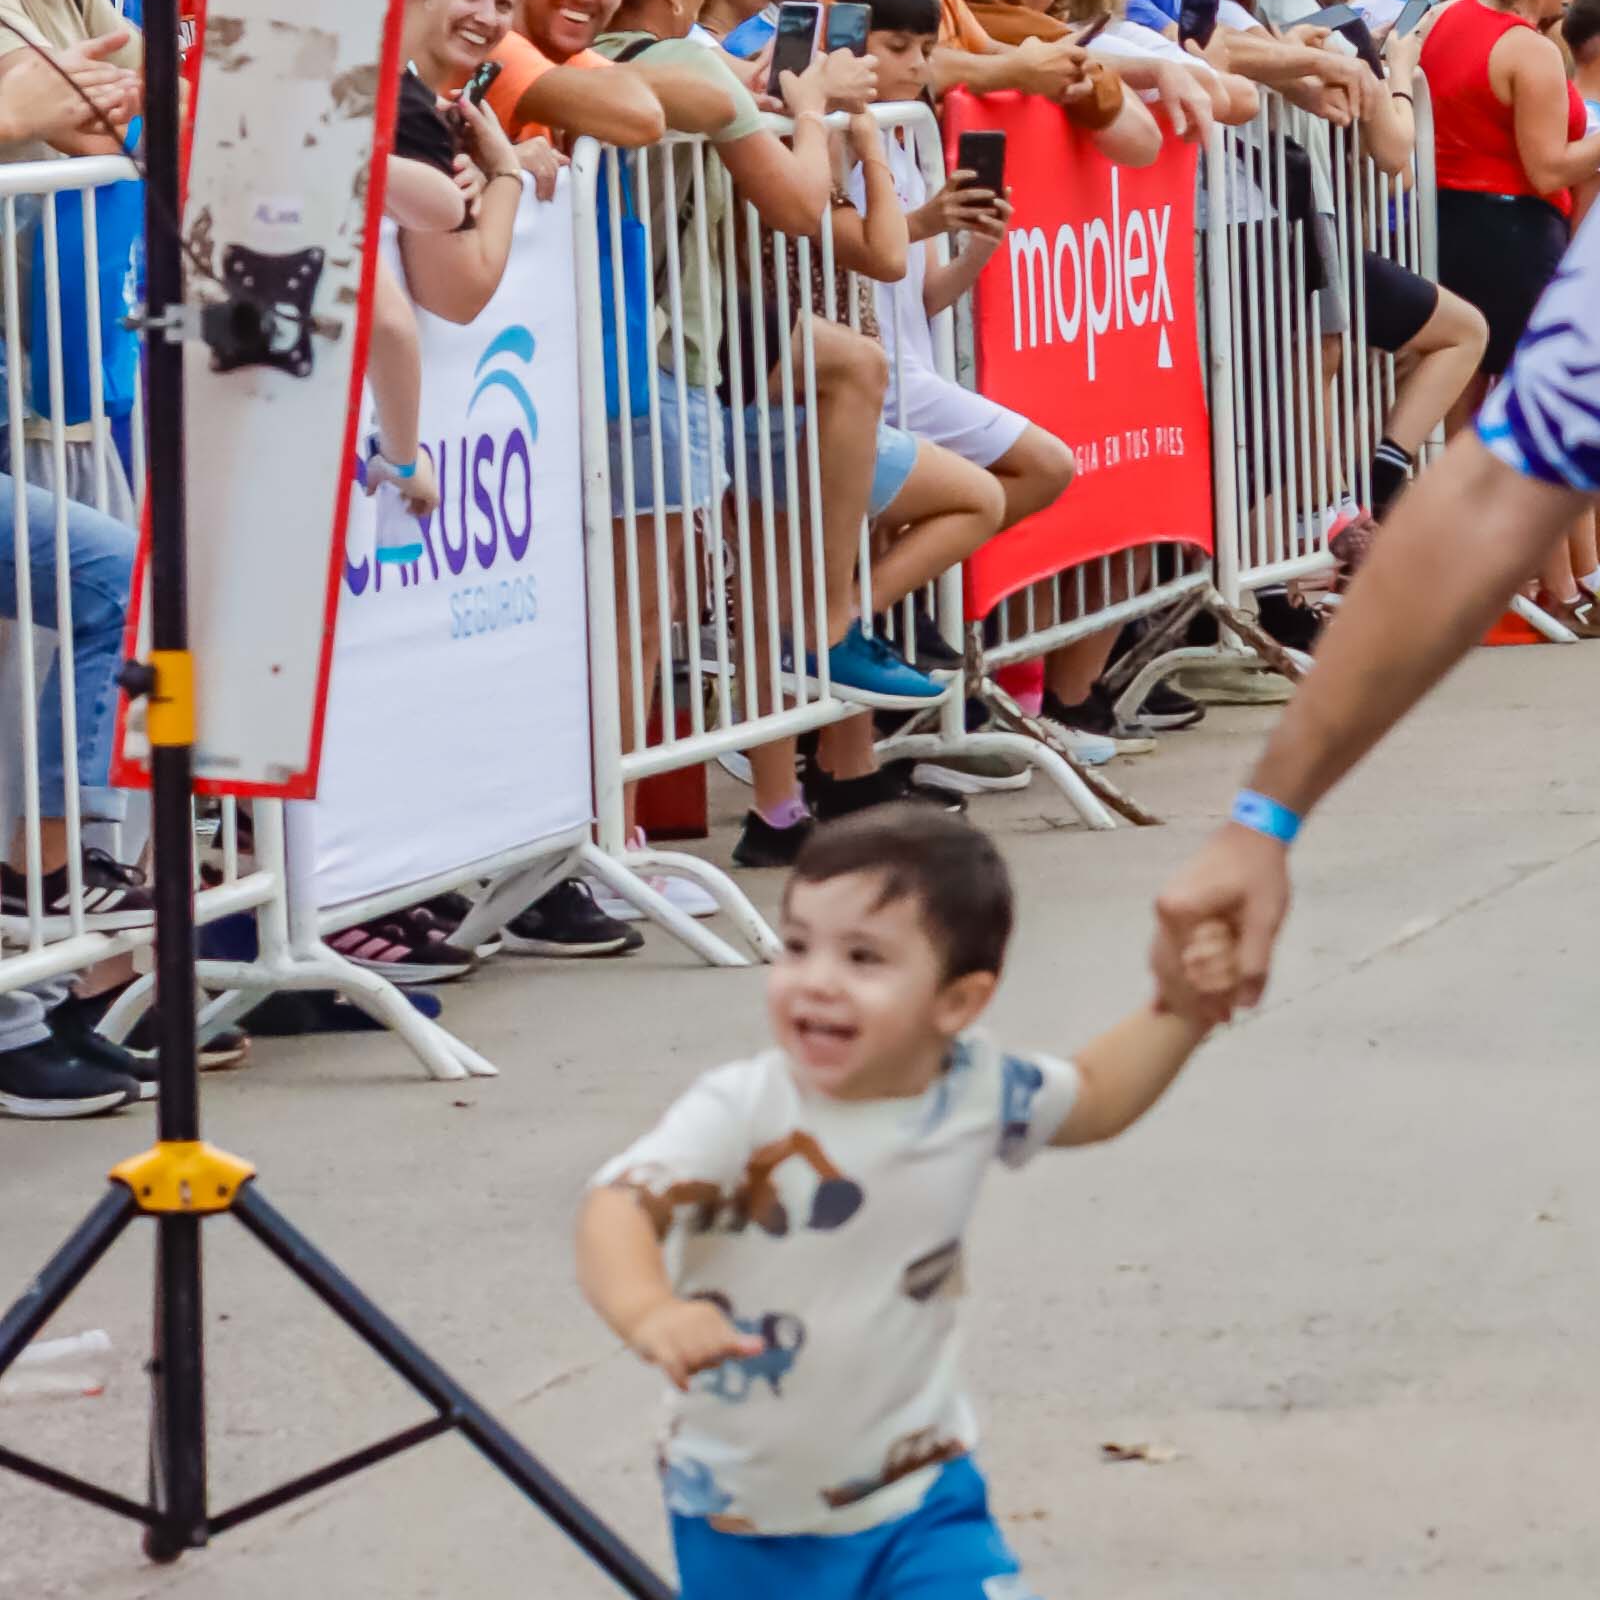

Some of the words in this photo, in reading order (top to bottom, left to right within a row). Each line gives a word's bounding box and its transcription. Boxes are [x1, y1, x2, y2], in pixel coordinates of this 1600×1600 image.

[1008, 166, 1174, 382] moplex
[1104, 434, 1121, 467] EN
[1124, 427, 1150, 460] TUS
[1154, 425, 1184, 456] PIES
[344, 427, 531, 596] RUSO
[450, 574, 537, 639] SEGUROS
